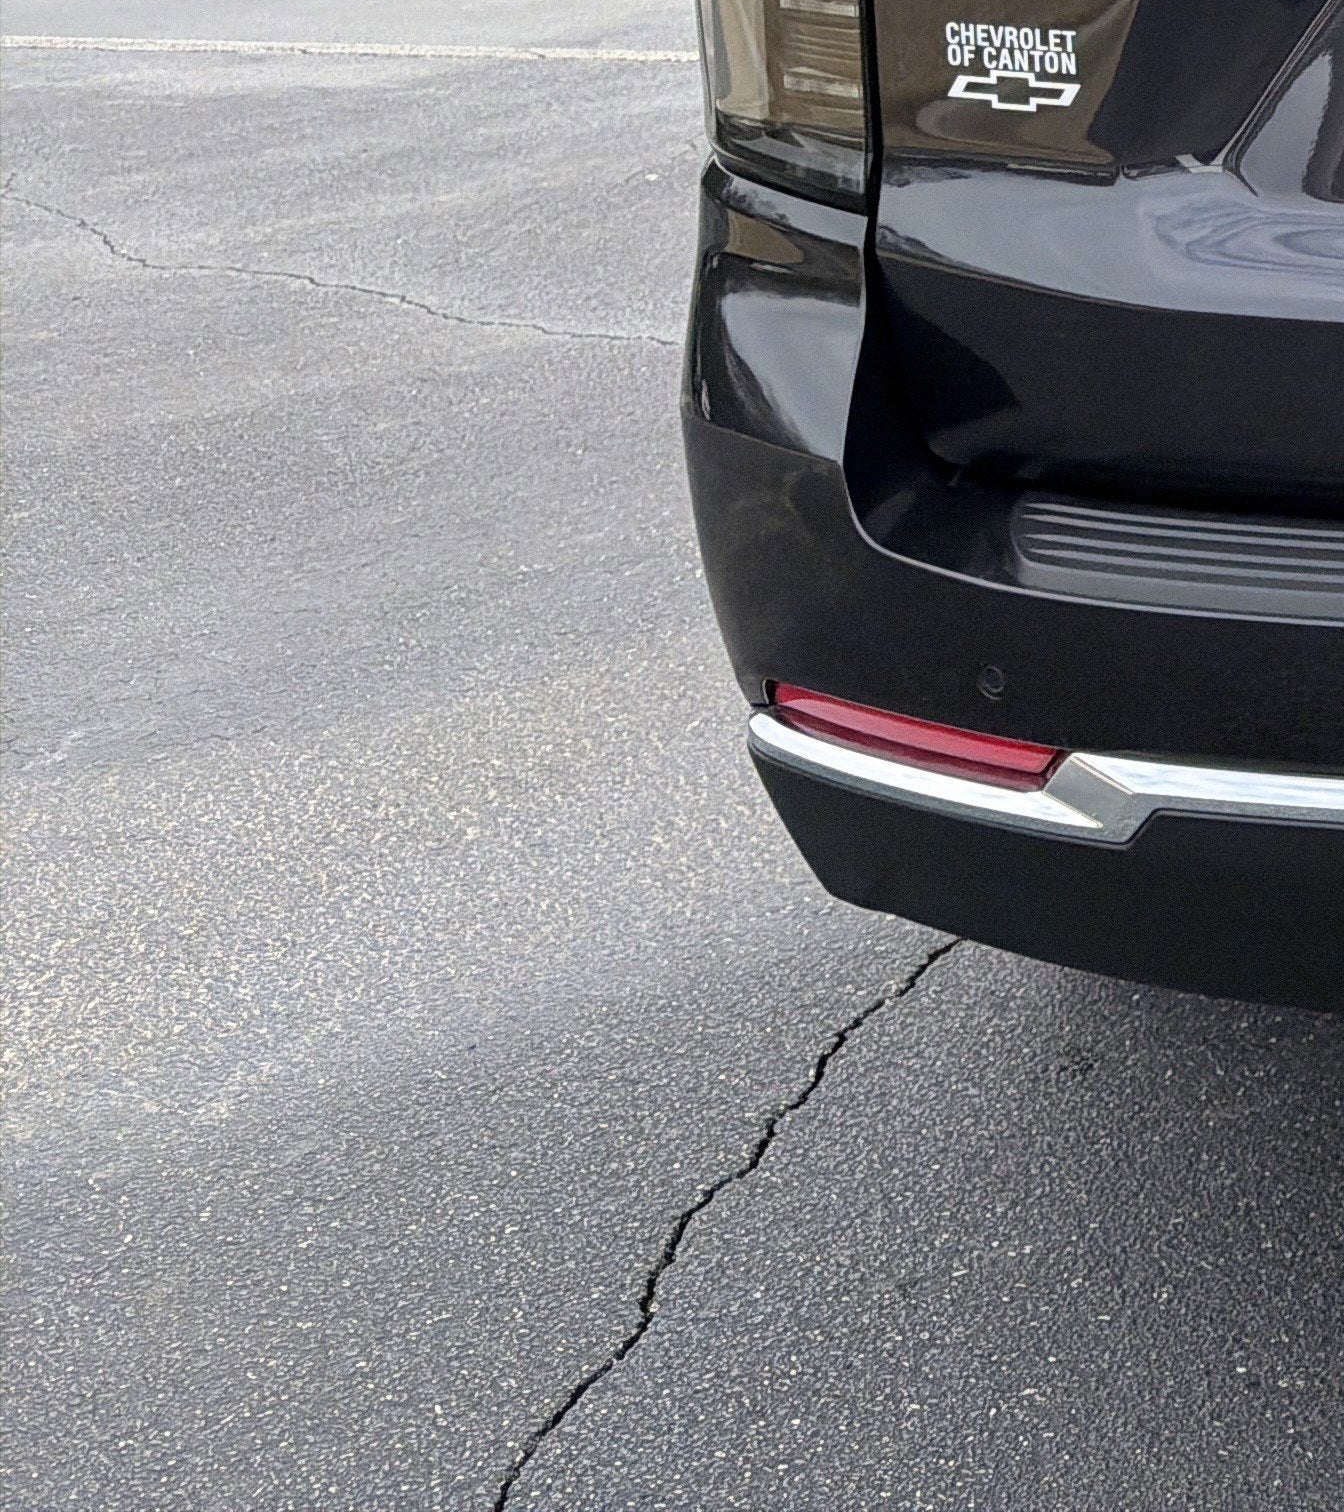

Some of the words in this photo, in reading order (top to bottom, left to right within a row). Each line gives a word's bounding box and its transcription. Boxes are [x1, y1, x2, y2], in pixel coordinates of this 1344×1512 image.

[944, 21, 1077, 53] CHEVROLET
[946, 44, 977, 67] OF
[983, 48, 1078, 76] CANTON
